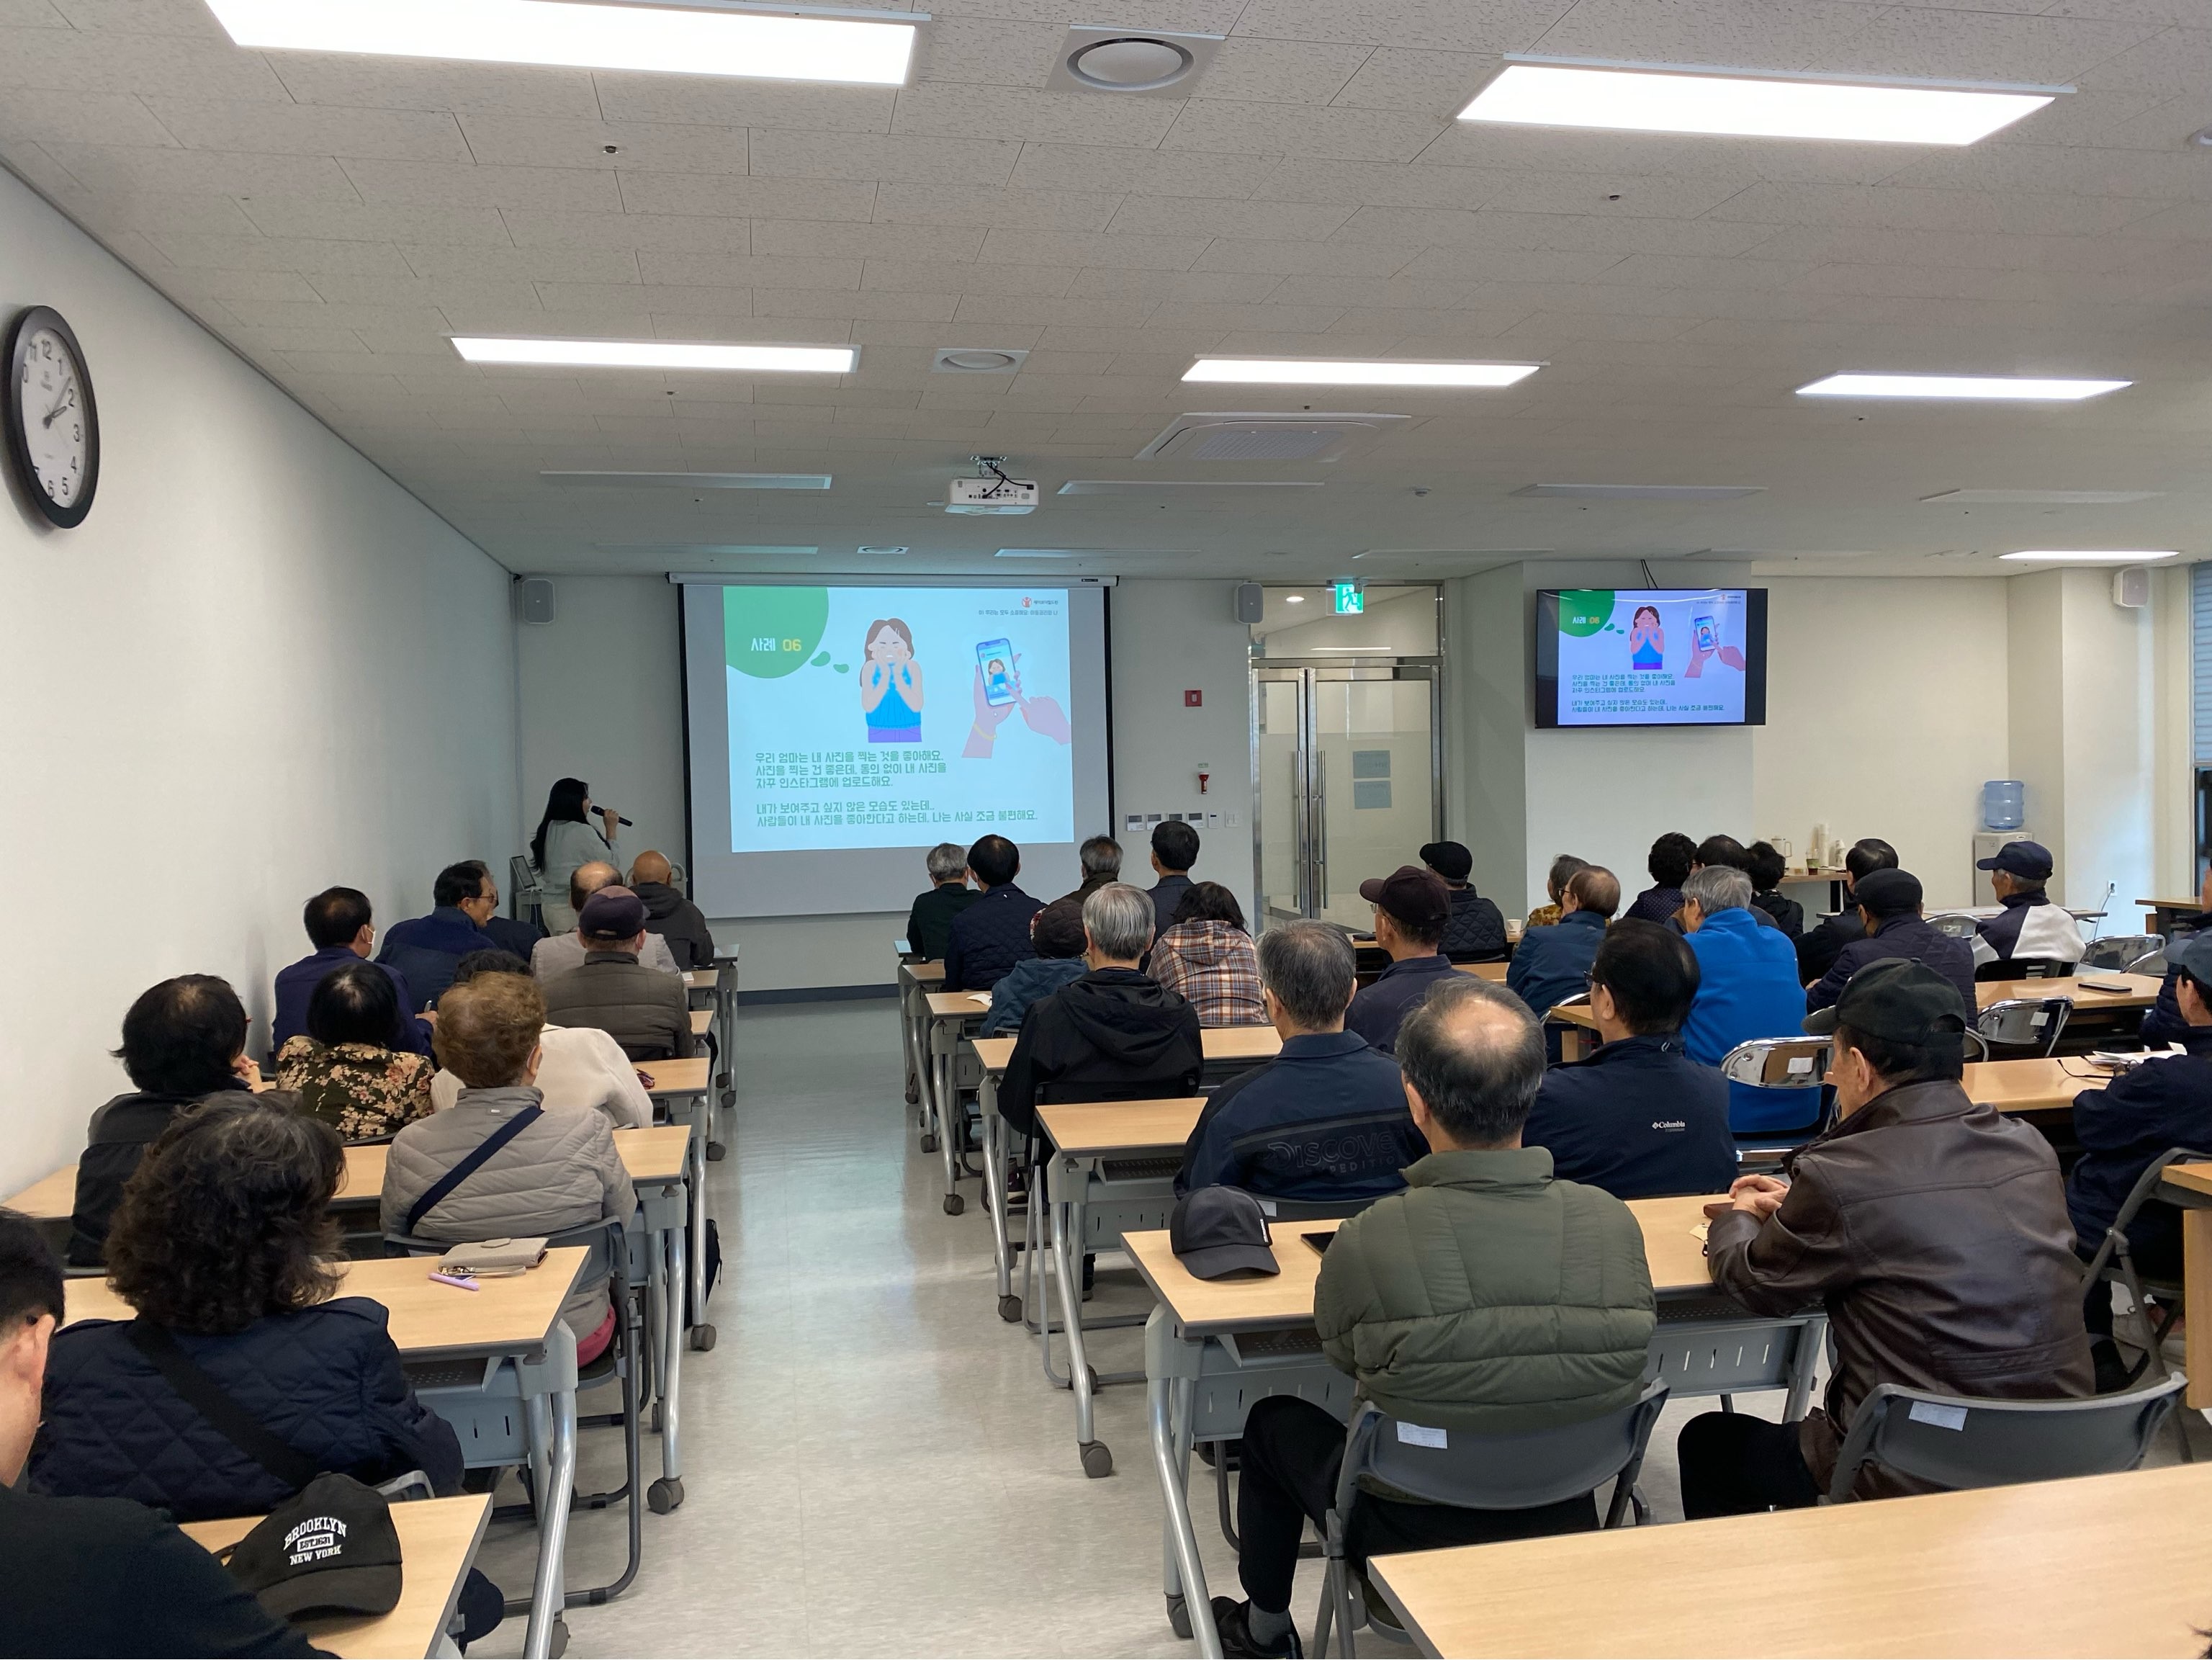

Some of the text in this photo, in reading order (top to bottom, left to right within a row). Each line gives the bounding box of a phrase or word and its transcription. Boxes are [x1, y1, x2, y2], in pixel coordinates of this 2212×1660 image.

[73, 423, 79, 443] 3
[71, 456, 76, 474] 4
[48, 480, 55, 499] 6
[62, 476, 68, 495] 5
[1572, 616, 1586, 624] 사례
[750, 637, 801, 652] 사례 06
[755, 750, 944, 763] 우리 엄마는 내 사진을 찍는 것을 좋아해요.
[755, 765, 786, 776] 사진을
[789, 765, 809, 776] 찍는
[811, 764, 822, 776] 건
[860, 763, 880, 775] 동의
[883, 763, 902, 774] 없이
[904, 763, 914, 774] 내
[919, 763, 947, 773] 사진을
[756, 776, 893, 789] 자꾸 인스타그램에 업로드해요.
[756, 804, 777, 815] 내가
[780, 803, 819, 814] 보여주고
[823, 802, 842, 813] 싶지
[846, 802, 866, 813] 않은
[868, 802, 897, 812] 모습도
[757, 815, 797, 827] 사람들이
[801, 815, 810, 826] 내
[814, 815, 843, 826] 사진을
[846, 813, 895, 825] 좋아한다고
[932, 812, 951, 824] 나는
[955, 812, 973, 823] 사실
[976, 811, 994, 822] 조금
[998, 810, 1038, 822] 불편해요.
[283, 1517, 346, 1551] BROOKLYN
[289, 1544, 342, 1566] NEW YORK
